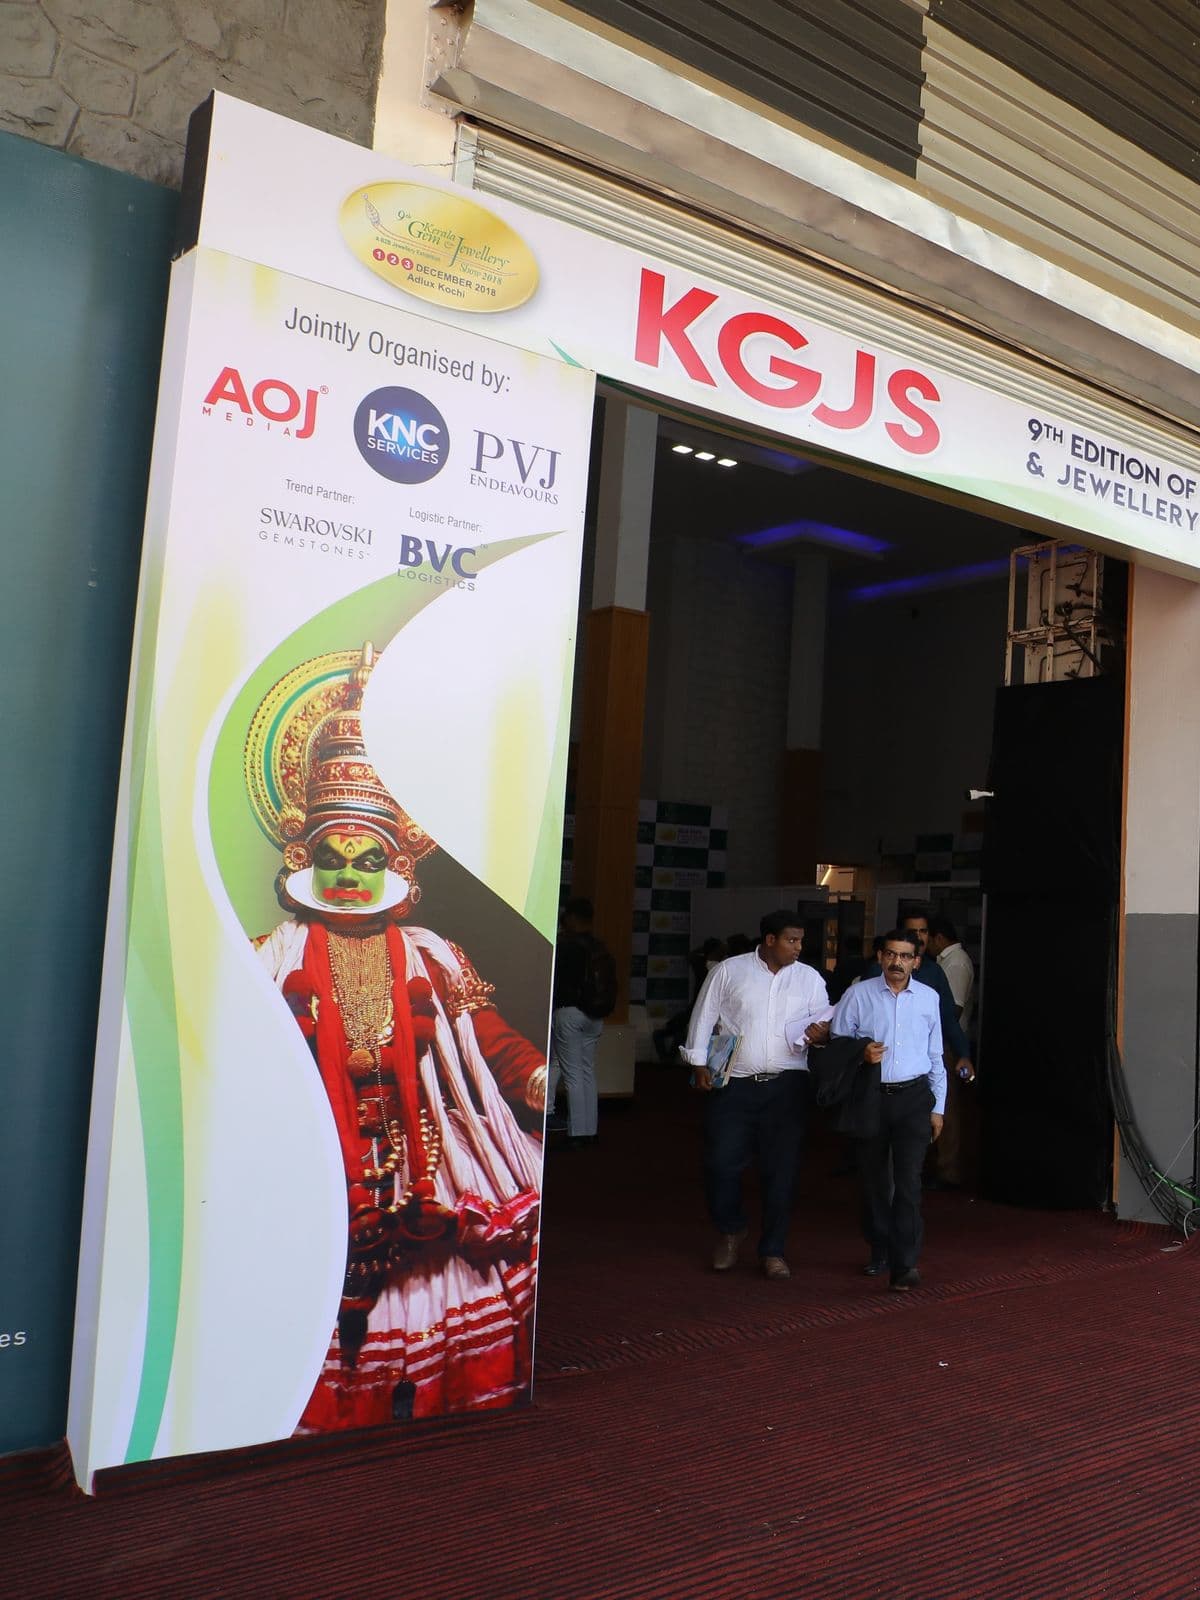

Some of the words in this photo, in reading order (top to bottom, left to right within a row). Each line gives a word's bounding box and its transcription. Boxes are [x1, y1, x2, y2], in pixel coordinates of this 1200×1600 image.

[408, 220, 440, 246] Gem
[449, 236, 510, 271] Jewellery
[423, 222, 456, 241] Kerala
[407, 273, 435, 289] Adlux
[438, 283, 466, 299] Kochi
[416, 263, 472, 289] DECEMBER
[475, 283, 497, 297] 2018
[285, 307, 361, 352] Jointly
[368, 331, 474, 382] Organised
[481, 363, 511, 394] by:
[634, 267, 941, 455] KGJS
[204, 366, 319, 439] AOJ
[202, 406, 291, 437] MEDIA
[367, 409, 441, 453] KNC
[367, 436, 439, 465] SERVICES
[470, 430, 562, 490] PVJ
[1027, 418, 1064, 445] 9TH
[1071, 433, 1160, 488] EDITION
[1167, 473, 1197, 500] OF
[285, 478, 313, 497] Trend
[316, 486, 355, 505] Partner:
[470, 473, 560, 506] ENDEAVOURS
[1026, 452, 1045, 479] &
[1057, 464, 1199, 532] JEWELLERY
[260, 507, 373, 546] SWAROVSKI
[409, 507, 445, 526] Logistic
[258, 530, 366, 560] GEMSTONES
[399, 534, 478, 580] BVC
[398, 569, 476, 592] LOGISTICS
